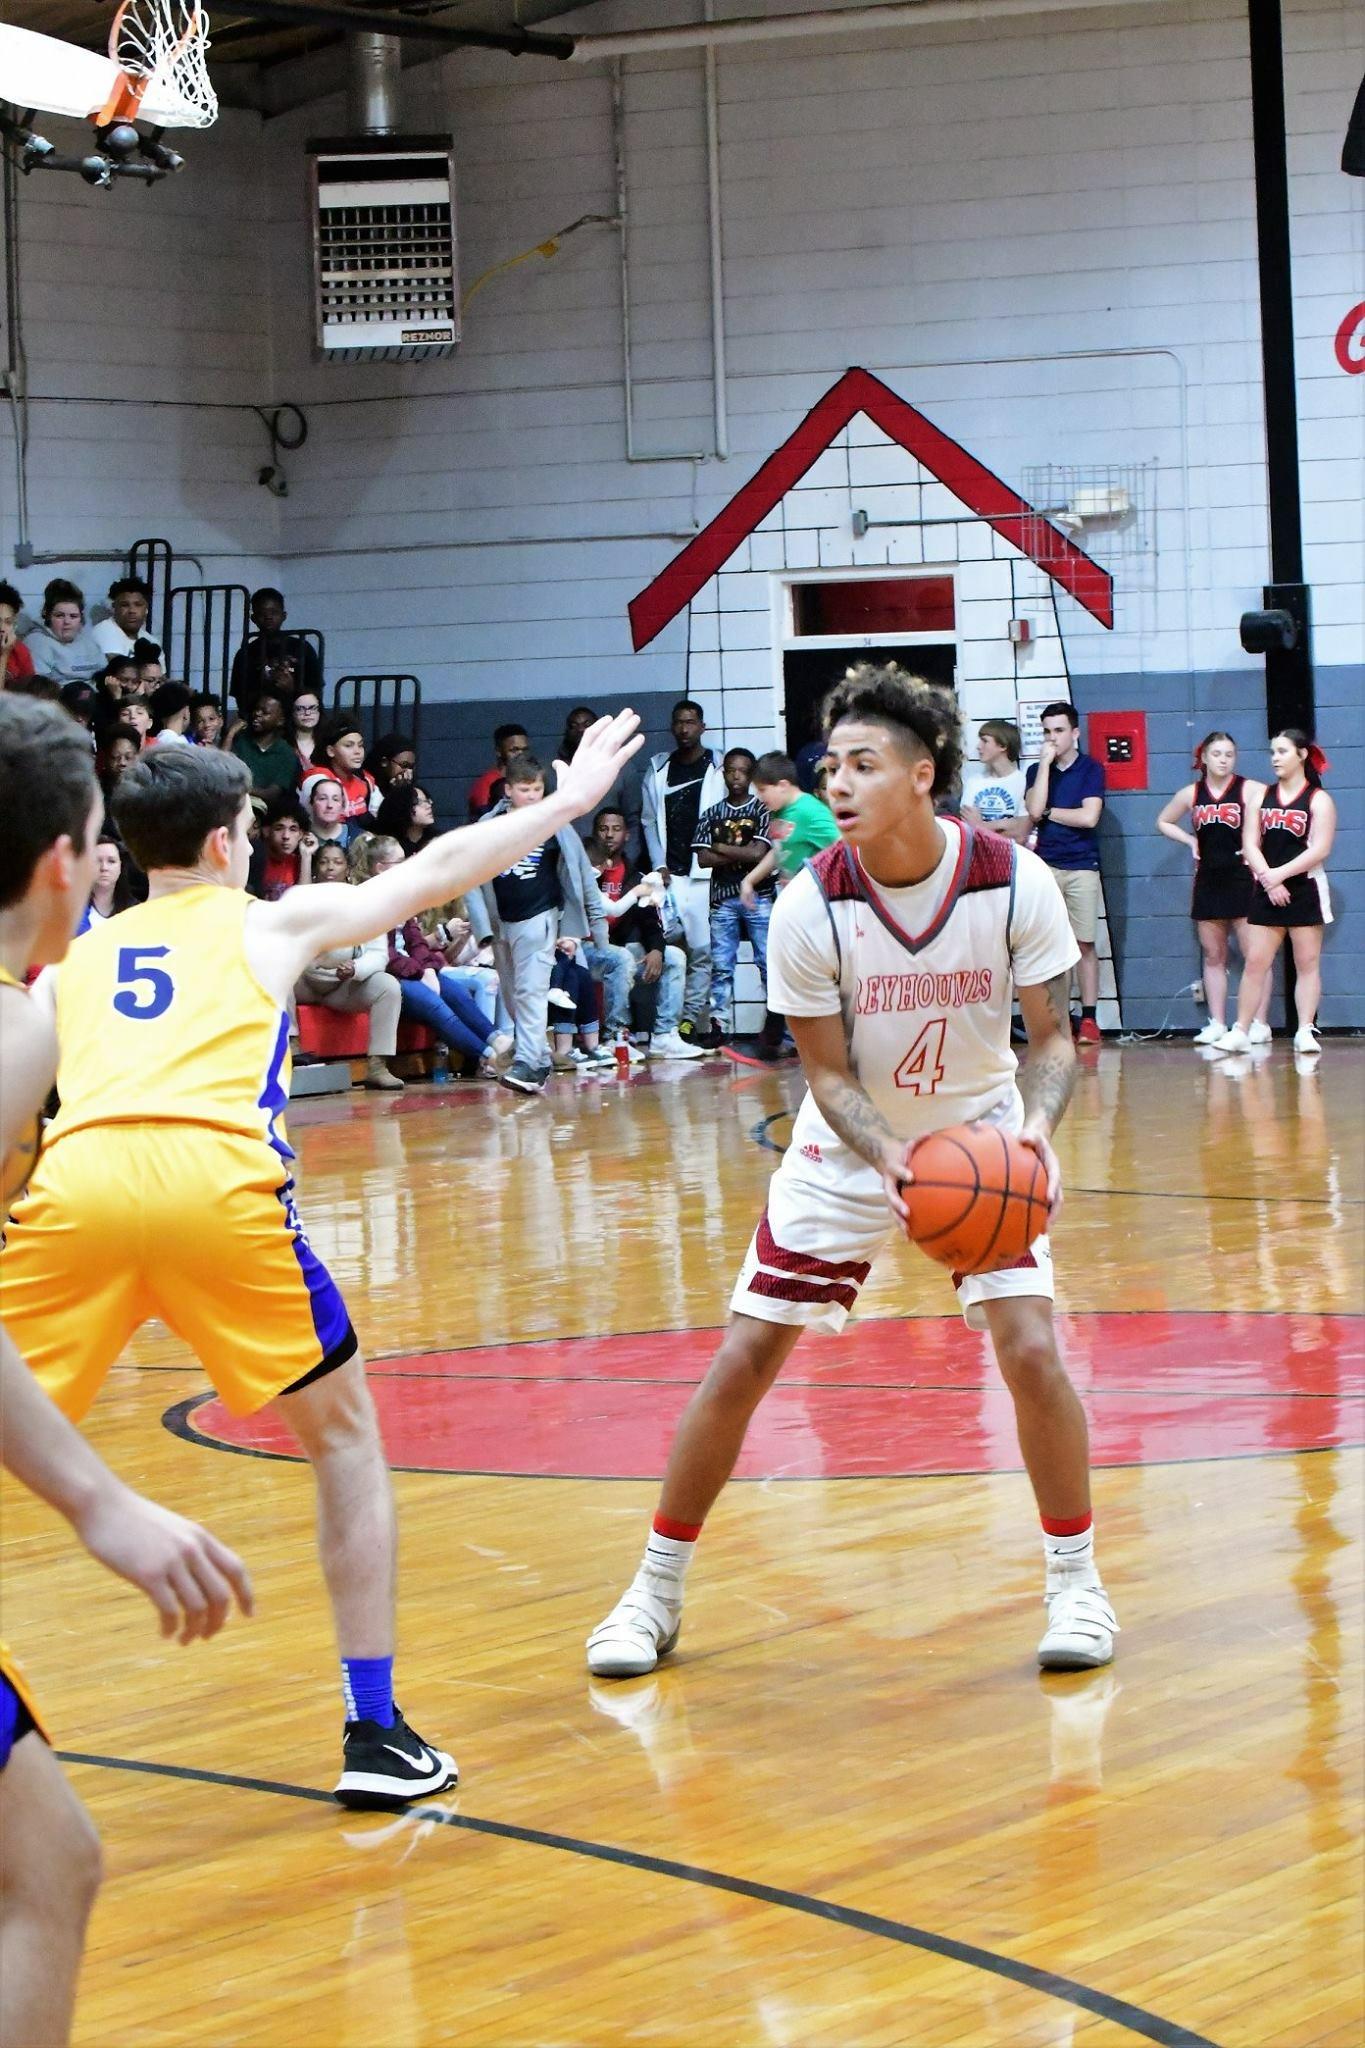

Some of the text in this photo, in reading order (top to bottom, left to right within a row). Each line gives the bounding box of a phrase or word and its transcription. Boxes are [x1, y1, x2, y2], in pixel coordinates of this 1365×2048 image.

[402, 331, 451, 342] REZNOR
[1193, 803, 1240, 830] WHS
[1261, 808, 1307, 837] WHS
[114, 945, 174, 1019] 5
[894, 1018, 947, 1096] 4
[800, 1149, 822, 1163] adidas
